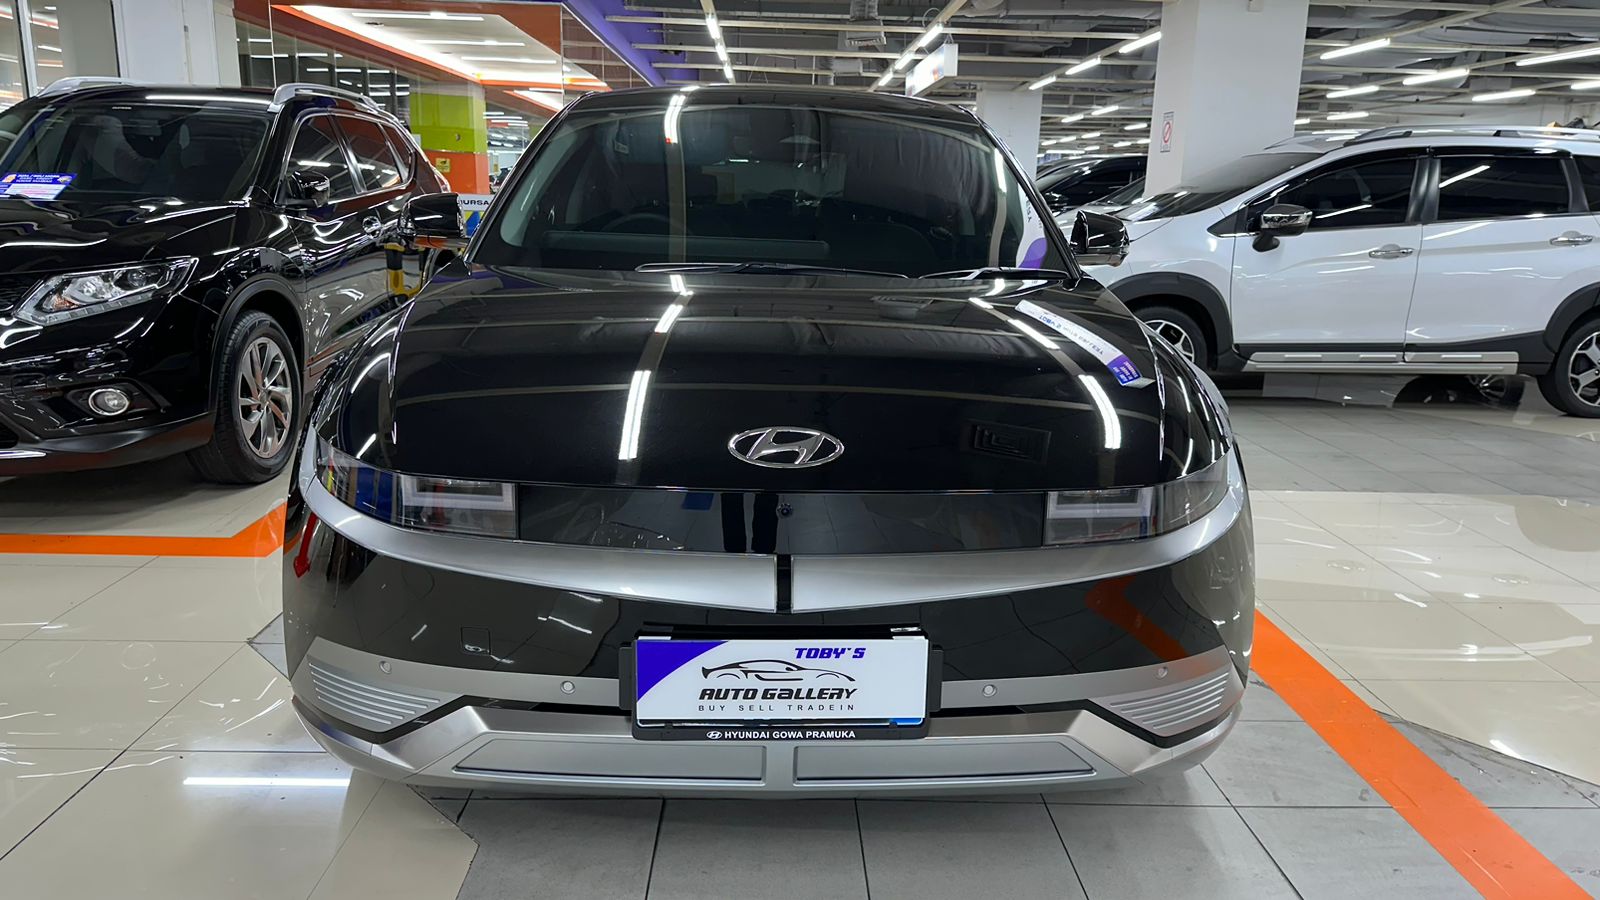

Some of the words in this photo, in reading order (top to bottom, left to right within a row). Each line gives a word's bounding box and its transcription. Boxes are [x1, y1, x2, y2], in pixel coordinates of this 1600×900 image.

[795, 648, 866, 659] TOBY'S
[699, 688, 758, 700] AUTO
[724, 731, 771, 739] HYUNDAI
[772, 731, 804, 739] GOWA
[805, 731, 856, 739] PRAMUKA
